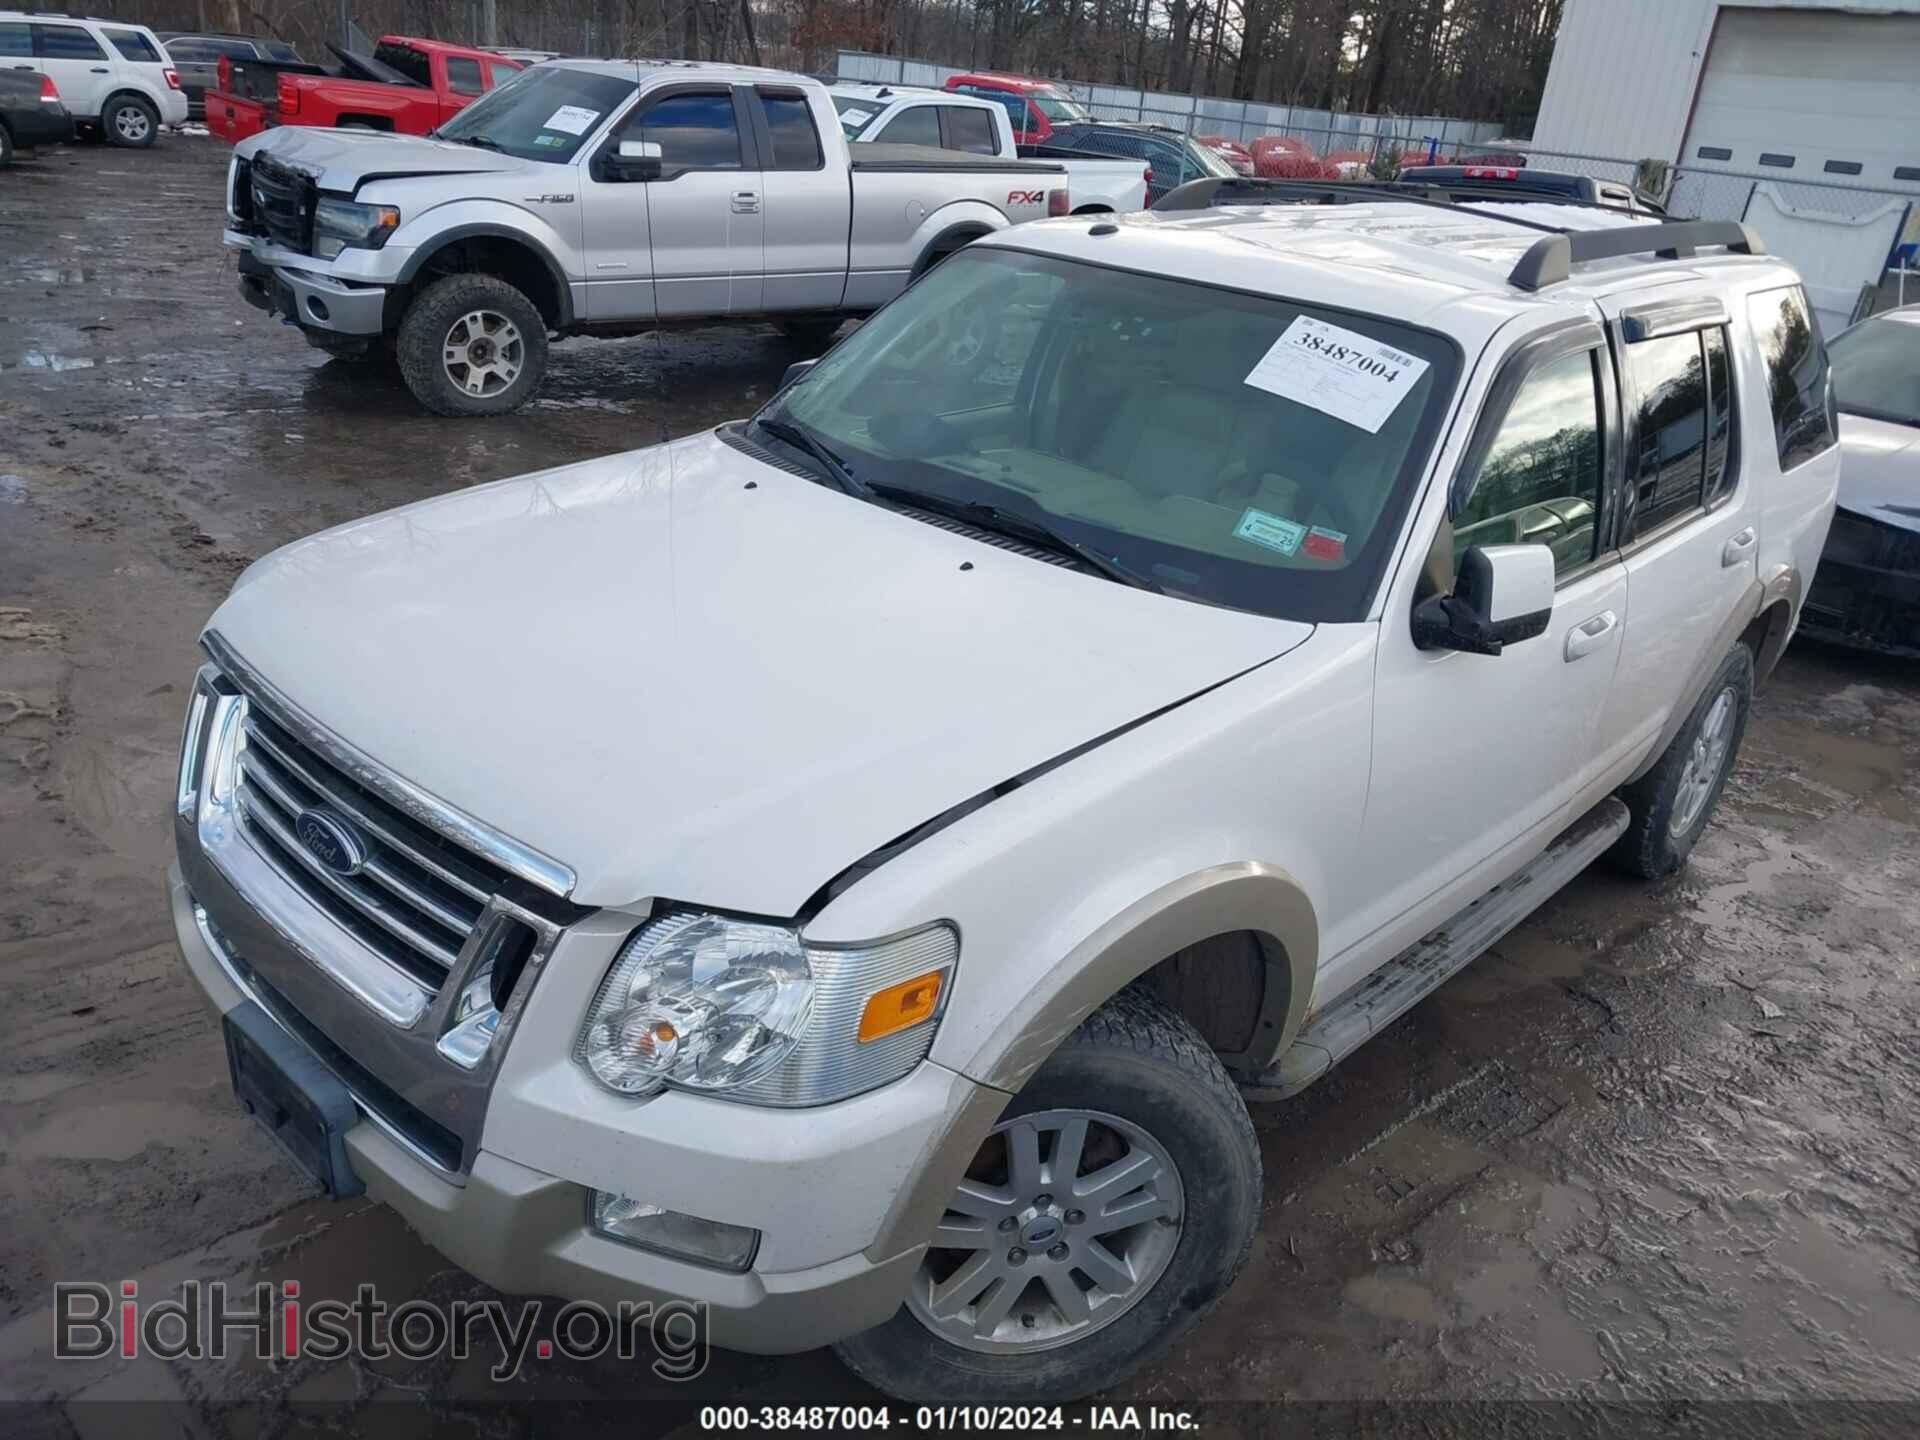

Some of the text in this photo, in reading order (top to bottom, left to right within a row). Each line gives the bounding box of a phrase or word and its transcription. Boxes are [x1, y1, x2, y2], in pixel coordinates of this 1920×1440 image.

[1007, 190, 1045, 204] FX4
[1294, 332, 1400, 383] 38487004
[304, 822, 337, 863] Ford
